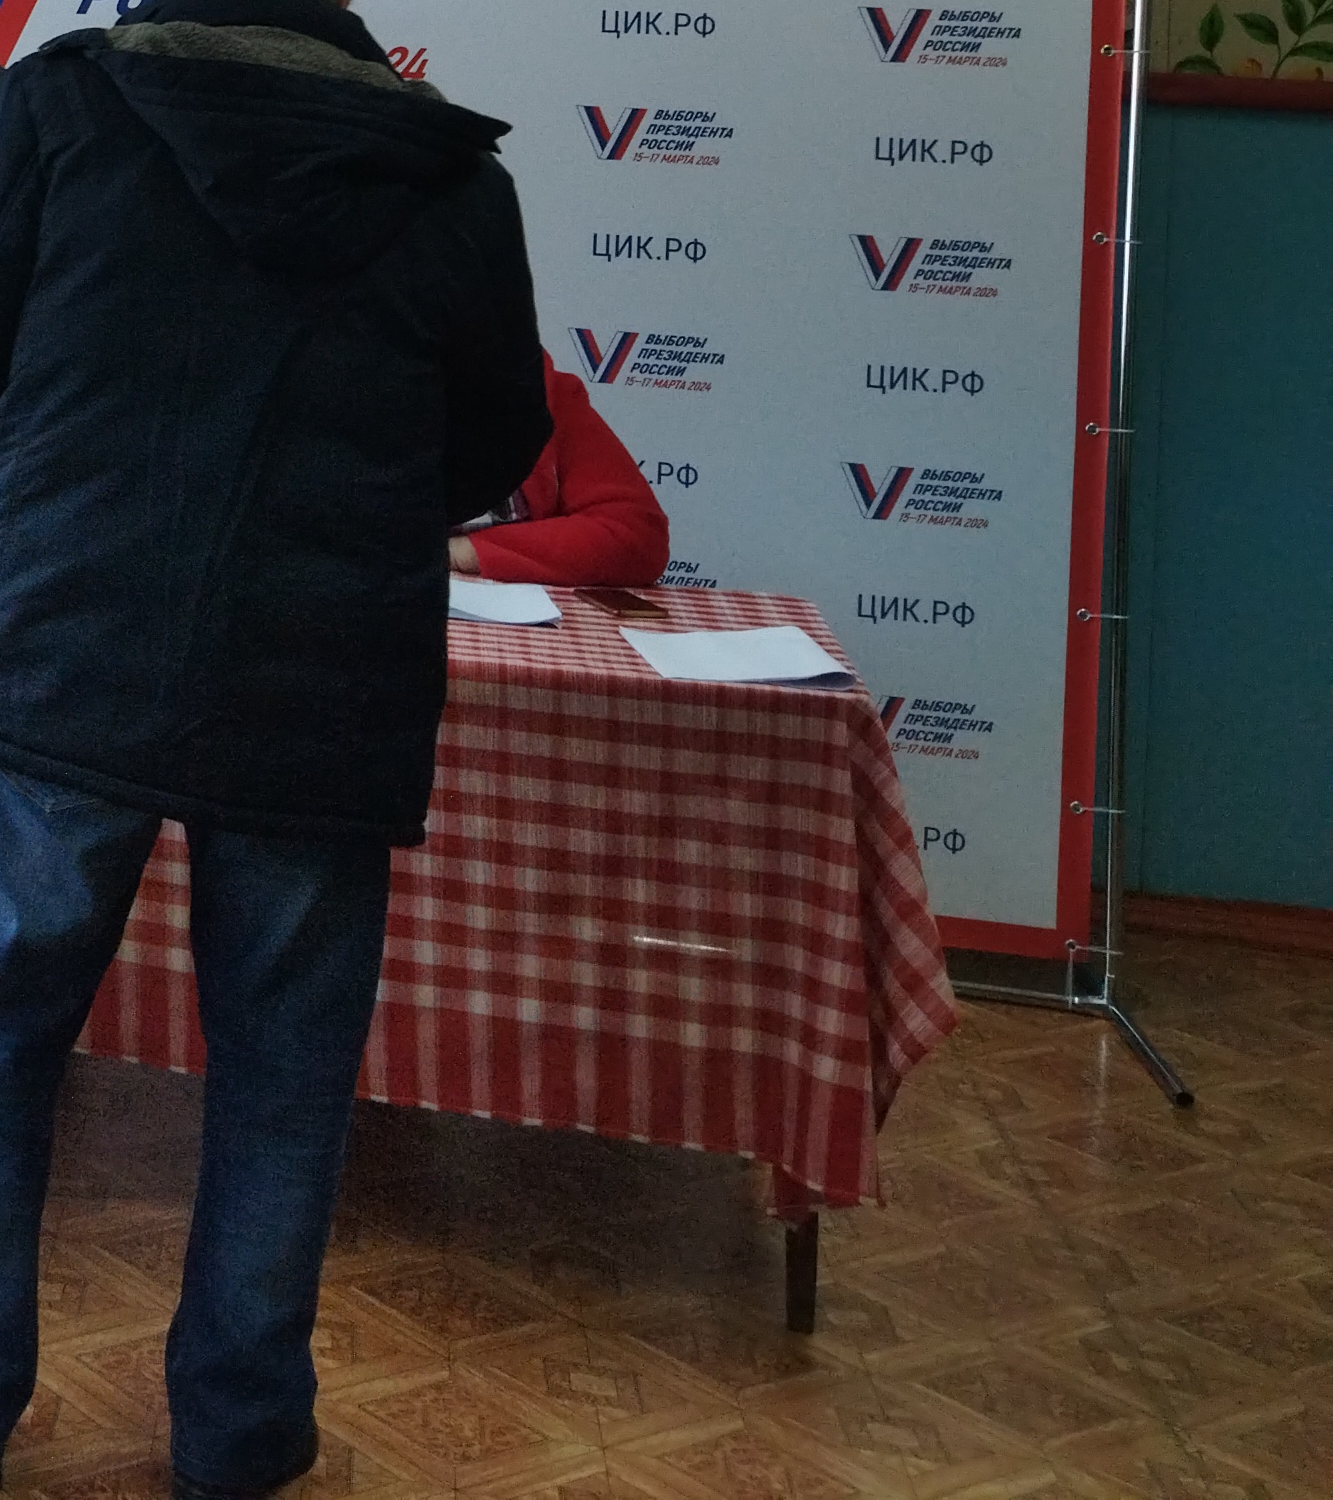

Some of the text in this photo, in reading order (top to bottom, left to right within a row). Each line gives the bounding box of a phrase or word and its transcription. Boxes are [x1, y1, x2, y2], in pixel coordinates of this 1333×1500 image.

[939, 10, 1003, 23] ВЫБОРЫ
[601, 9, 716, 39] ЦИК.РФ
[931, 25, 1021, 39] ПРЕЗИДЕНТА
[923, 40, 982, 52] РОССИИ
[945, 56, 980, 66] МАРТА
[982, 57, 1007, 68] 2024
[654, 110, 717, 122] ВЫБОРЫ
[645, 124, 734, 138] ПРЕЗИДЕНТА
[639, 139, 695, 151] РОССИИ
[875, 136, 994, 167] ЦИК.РФ
[661, 154, 694, 165] МАРТА
[695, 156, 721, 166] 2024
[592, 232, 707, 264] ЦИК.РФ
[929, 240, 994, 254] ВЫБОРЫ
[921, 254, 1012, 270] ПРЕЗИДЕНТА
[914, 270, 973, 283] РОССИИ
[936, 285, 971, 296] МАРТА
[973, 287, 999, 298] 2024
[645, 334, 707, 348] ВЫБОРЫ
[637, 348, 725, 365] ПРЕЗИДЕНТА
[631, 362, 687, 377] РОССИИ
[652, 378, 686, 390] МАРТА
[687, 380, 711, 392] 2024
[866, 364, 985, 397] ЦИК.РФ
[920, 469, 985, 484] ВЫБОРЫ
[913, 484, 1003, 501] ПРЕЗИДЕНТА
[905, 499, 963, 513] РОССИИ
[928, 514, 962, 526] МАРТА
[963, 518, 989, 530] 2024
[667, 560, 701, 574] ОРЫ
[657, 575, 717, 588] ЗИДЕНТА
[857, 593, 975, 628] ЦИК.РФ
[911, 699, 975, 715] ВЫБОРЫ
[903, 714, 994, 732] ПРЕЗИДЕНТА
[896, 728, 954, 744] РОССИИ
[919, 745, 953, 758] МАРТА
[955, 749, 980, 760] 2024
